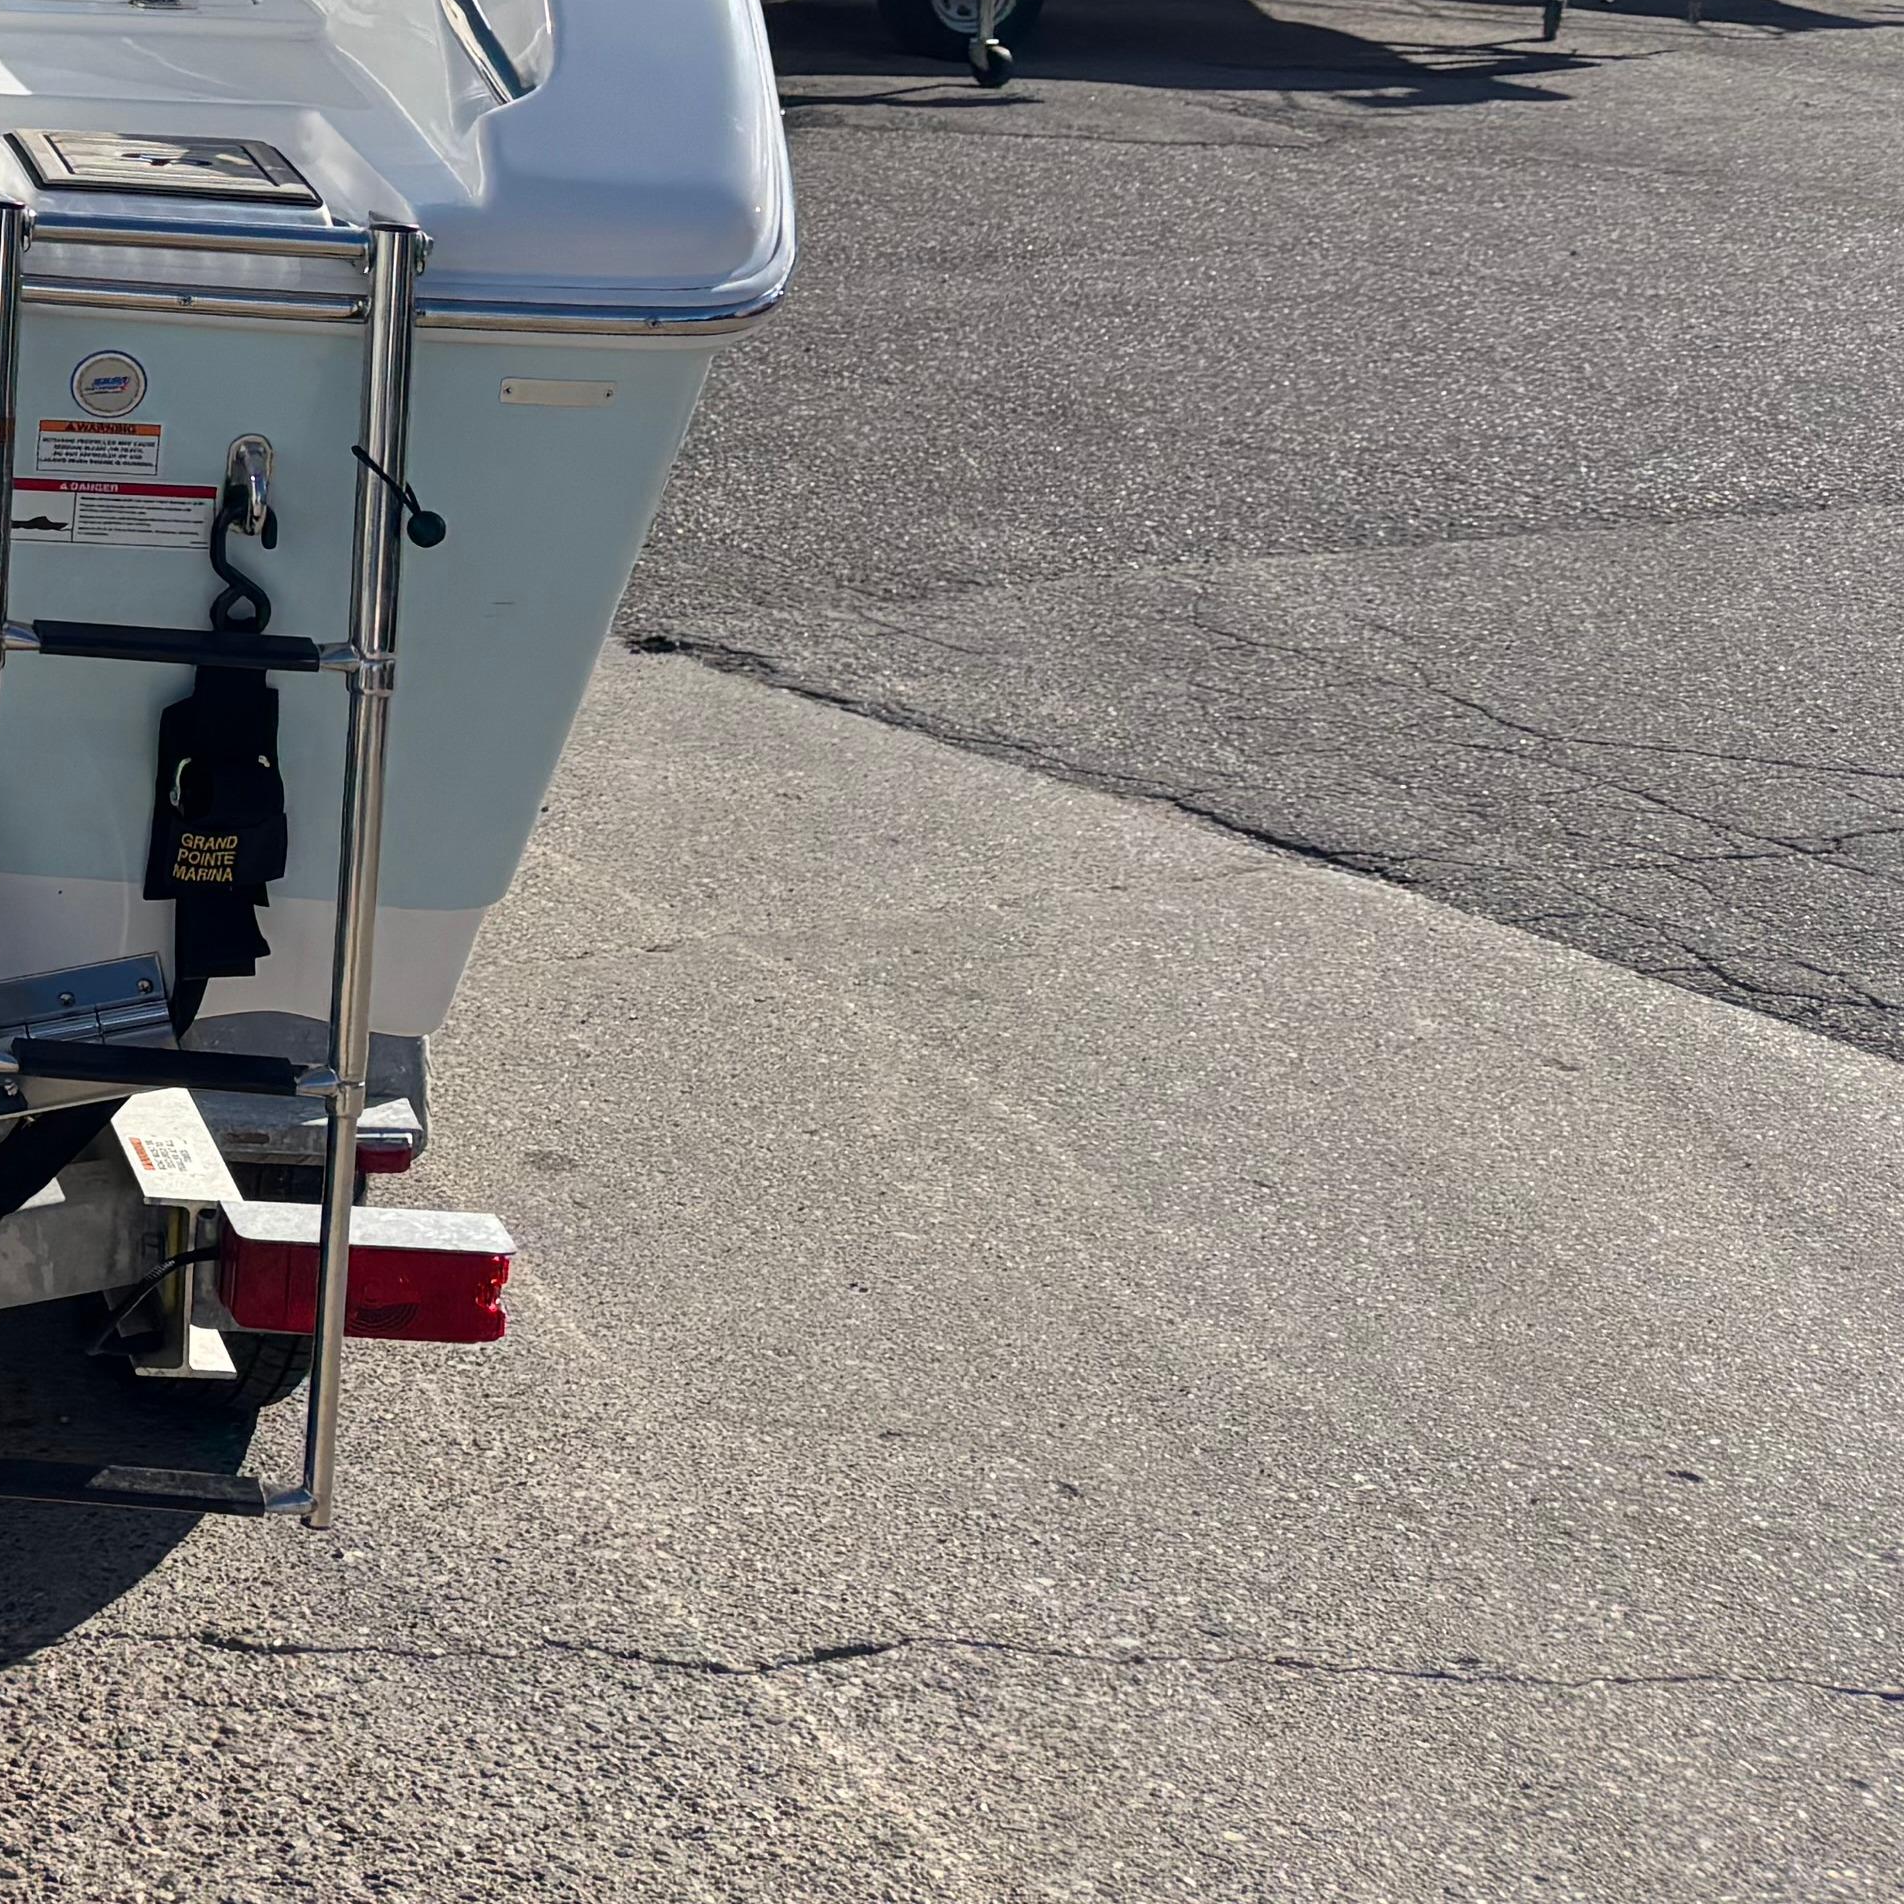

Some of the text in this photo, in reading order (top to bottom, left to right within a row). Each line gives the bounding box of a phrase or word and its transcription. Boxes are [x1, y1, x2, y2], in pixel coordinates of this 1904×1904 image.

[76, 423, 136, 435] WARNING
[70, 481, 119, 493] DANGER
[181, 833, 238, 851] GRAND
[177, 848, 235, 866] POINTE
[172, 863, 233, 882] MARINA
